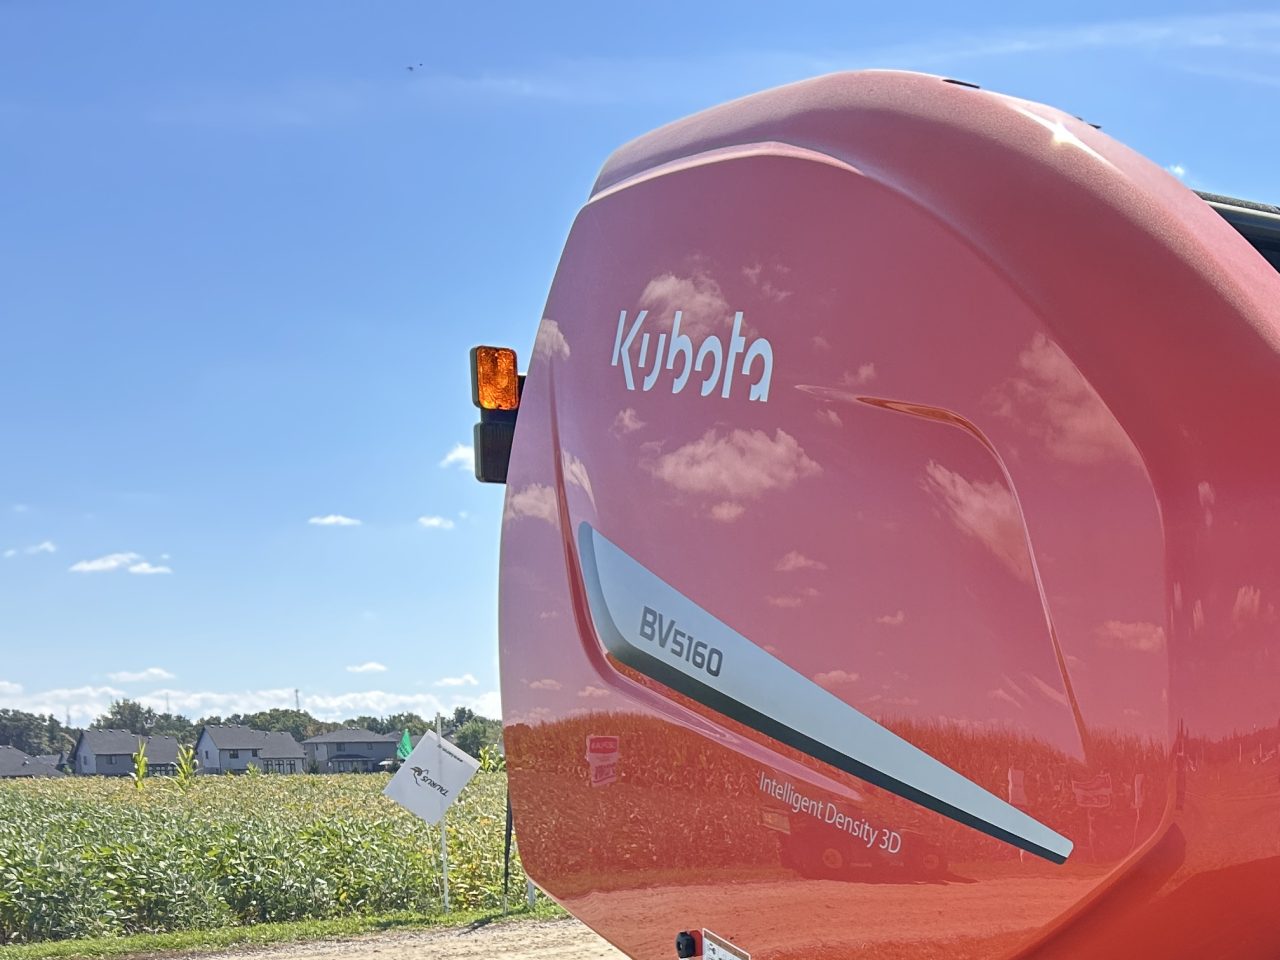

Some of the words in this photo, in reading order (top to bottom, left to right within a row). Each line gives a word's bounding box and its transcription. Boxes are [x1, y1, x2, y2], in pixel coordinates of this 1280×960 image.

[611, 310, 773, 402] Kubota
[639, 605, 723, 678] BV5160
[759, 771, 823, 820] Intelligent
[824, 802, 878, 848] Density
[879, 828, 902, 854] 3D
